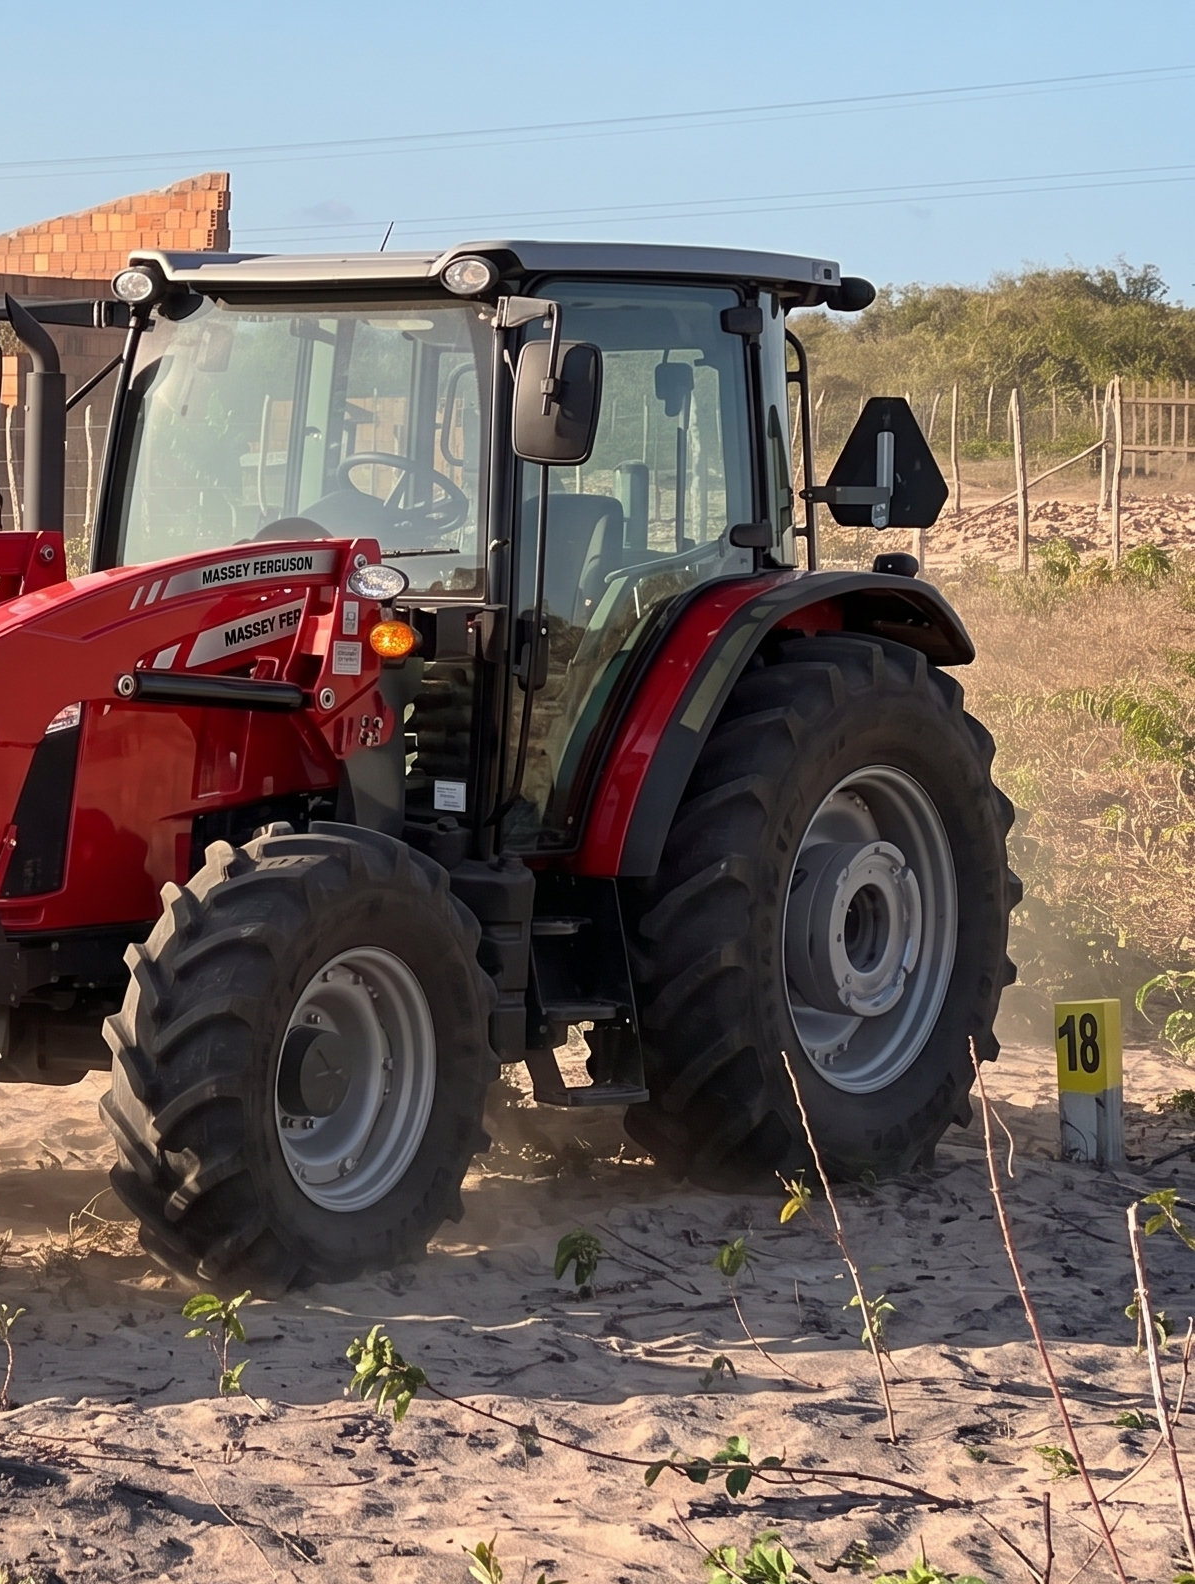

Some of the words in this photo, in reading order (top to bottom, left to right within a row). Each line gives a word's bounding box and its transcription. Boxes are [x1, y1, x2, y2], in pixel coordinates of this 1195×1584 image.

[202, 562, 250, 585] MASSEY
[253, 556, 313, 576] FERGUSON
[224, 616, 276, 647] MASSEY
[1058, 1012, 1100, 1074] 18
